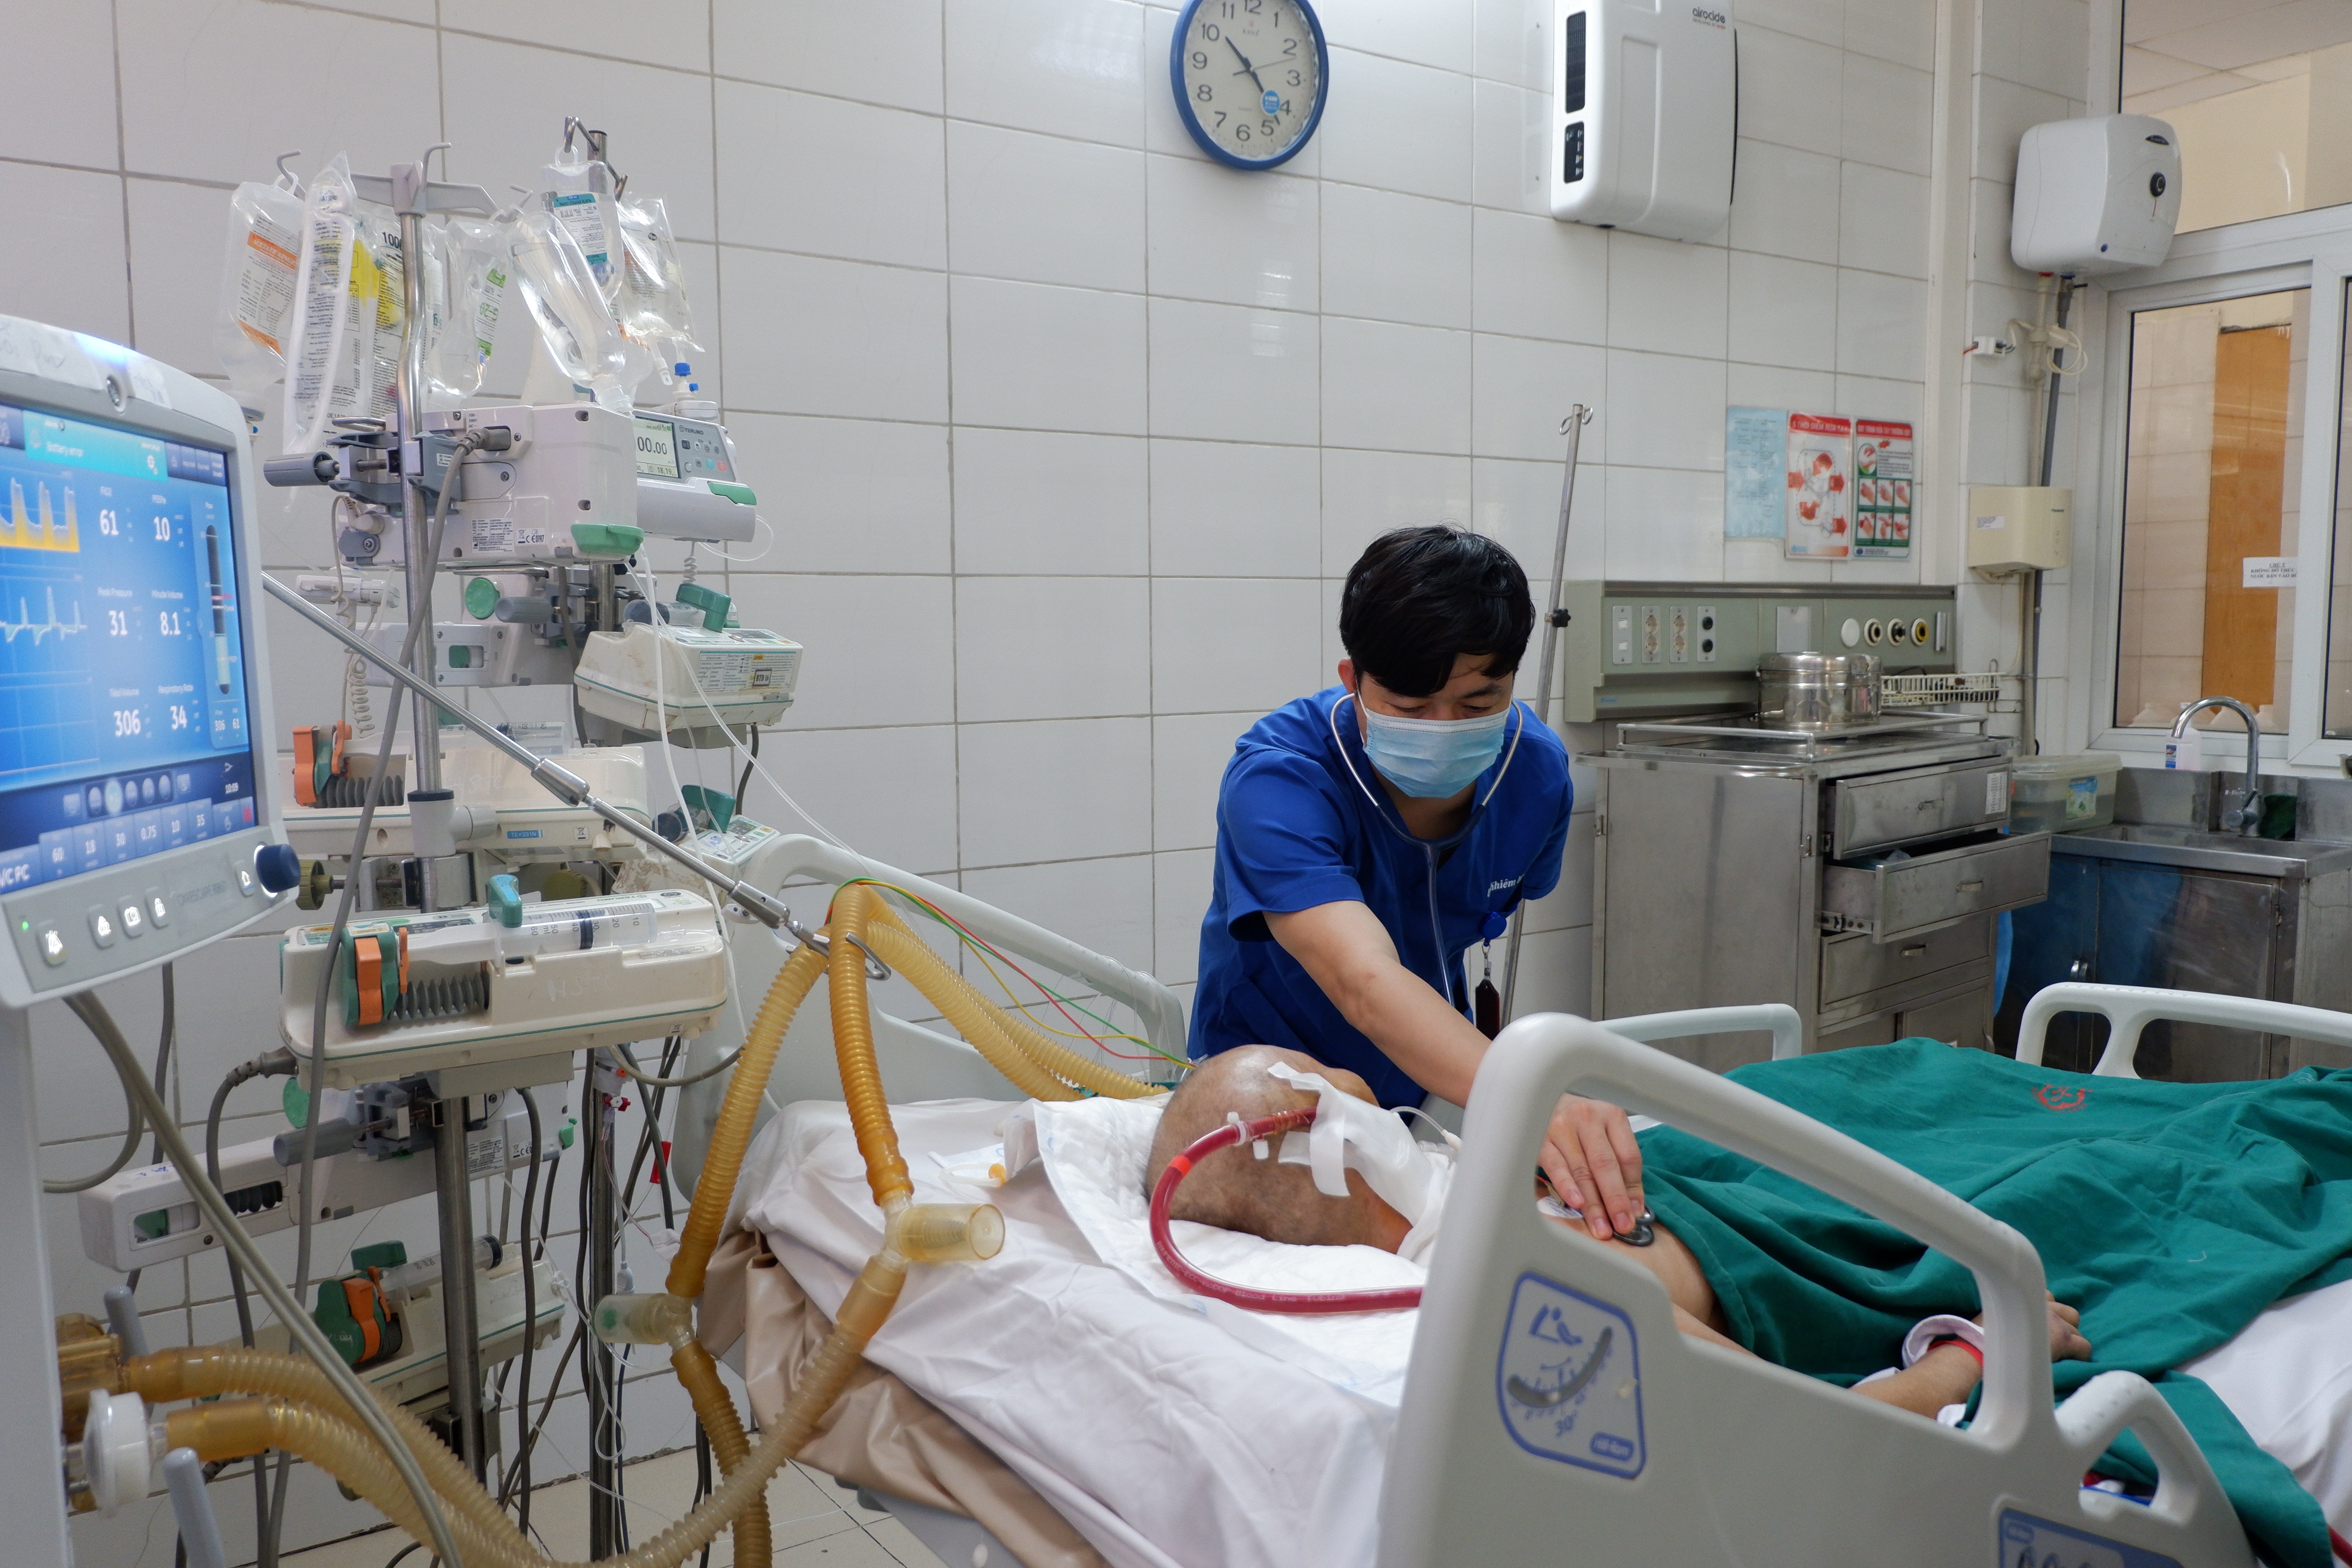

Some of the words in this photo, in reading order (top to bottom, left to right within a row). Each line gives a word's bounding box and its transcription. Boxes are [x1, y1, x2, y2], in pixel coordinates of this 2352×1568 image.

[1222, 2, 1234, 19] 11
[1244, 0, 1261, 15] 12
[1692, 6, 1726, 24] airocide
[1274, 12, 1279, 28] 1
[1202, 23, 1220, 42] 10
[1283, 38, 1297, 56] 2
[1192, 51, 1207, 69] 9
[1287, 69, 1300, 87] 3
[1197, 84, 1212, 102] 8
[1279, 99, 1292, 115] 4
[1214, 111, 1227, 128] 7
[1260, 120, 1274, 136] 5
[1236, 124, 1250, 141] 6
[100, 509, 118, 535] 61
[153, 516, 171, 541] 10
[108, 610, 127, 636] 31
[160, 611, 181, 636] 8.1
[113, 708, 141, 737] 306
[170, 705, 187, 730] 34
[214, 719, 226, 731] 306
[232, 718, 241, 730] 61
[196, 813, 205, 827] 35
[551, 924, 559, 934] 50
[572, 922, 579, 932] 40
[592, 920, 600, 930] 30
[612, 918, 620, 928] 20
[633, 916, 640, 926] 10
[530, 927, 539, 936] 60
